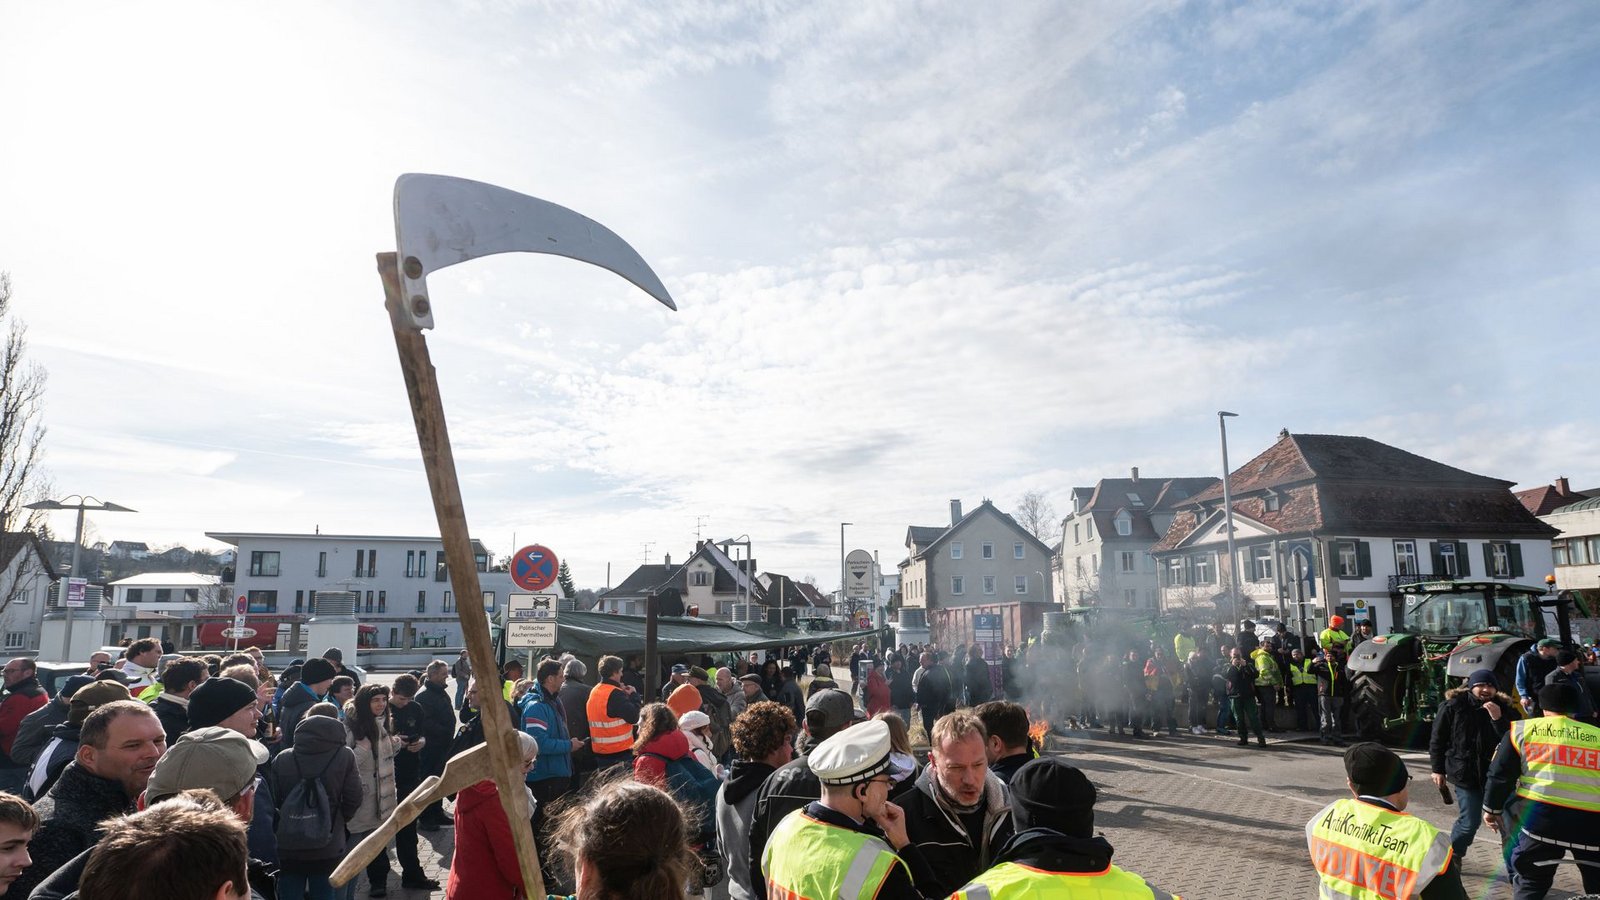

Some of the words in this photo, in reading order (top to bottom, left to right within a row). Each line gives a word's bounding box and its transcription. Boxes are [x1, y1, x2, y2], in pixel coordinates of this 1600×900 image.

[980, 616, 987, 625] P
[1321, 808, 1409, 856] AntiKonfliktTeam
[1315, 840, 1409, 900] POLIZEI
